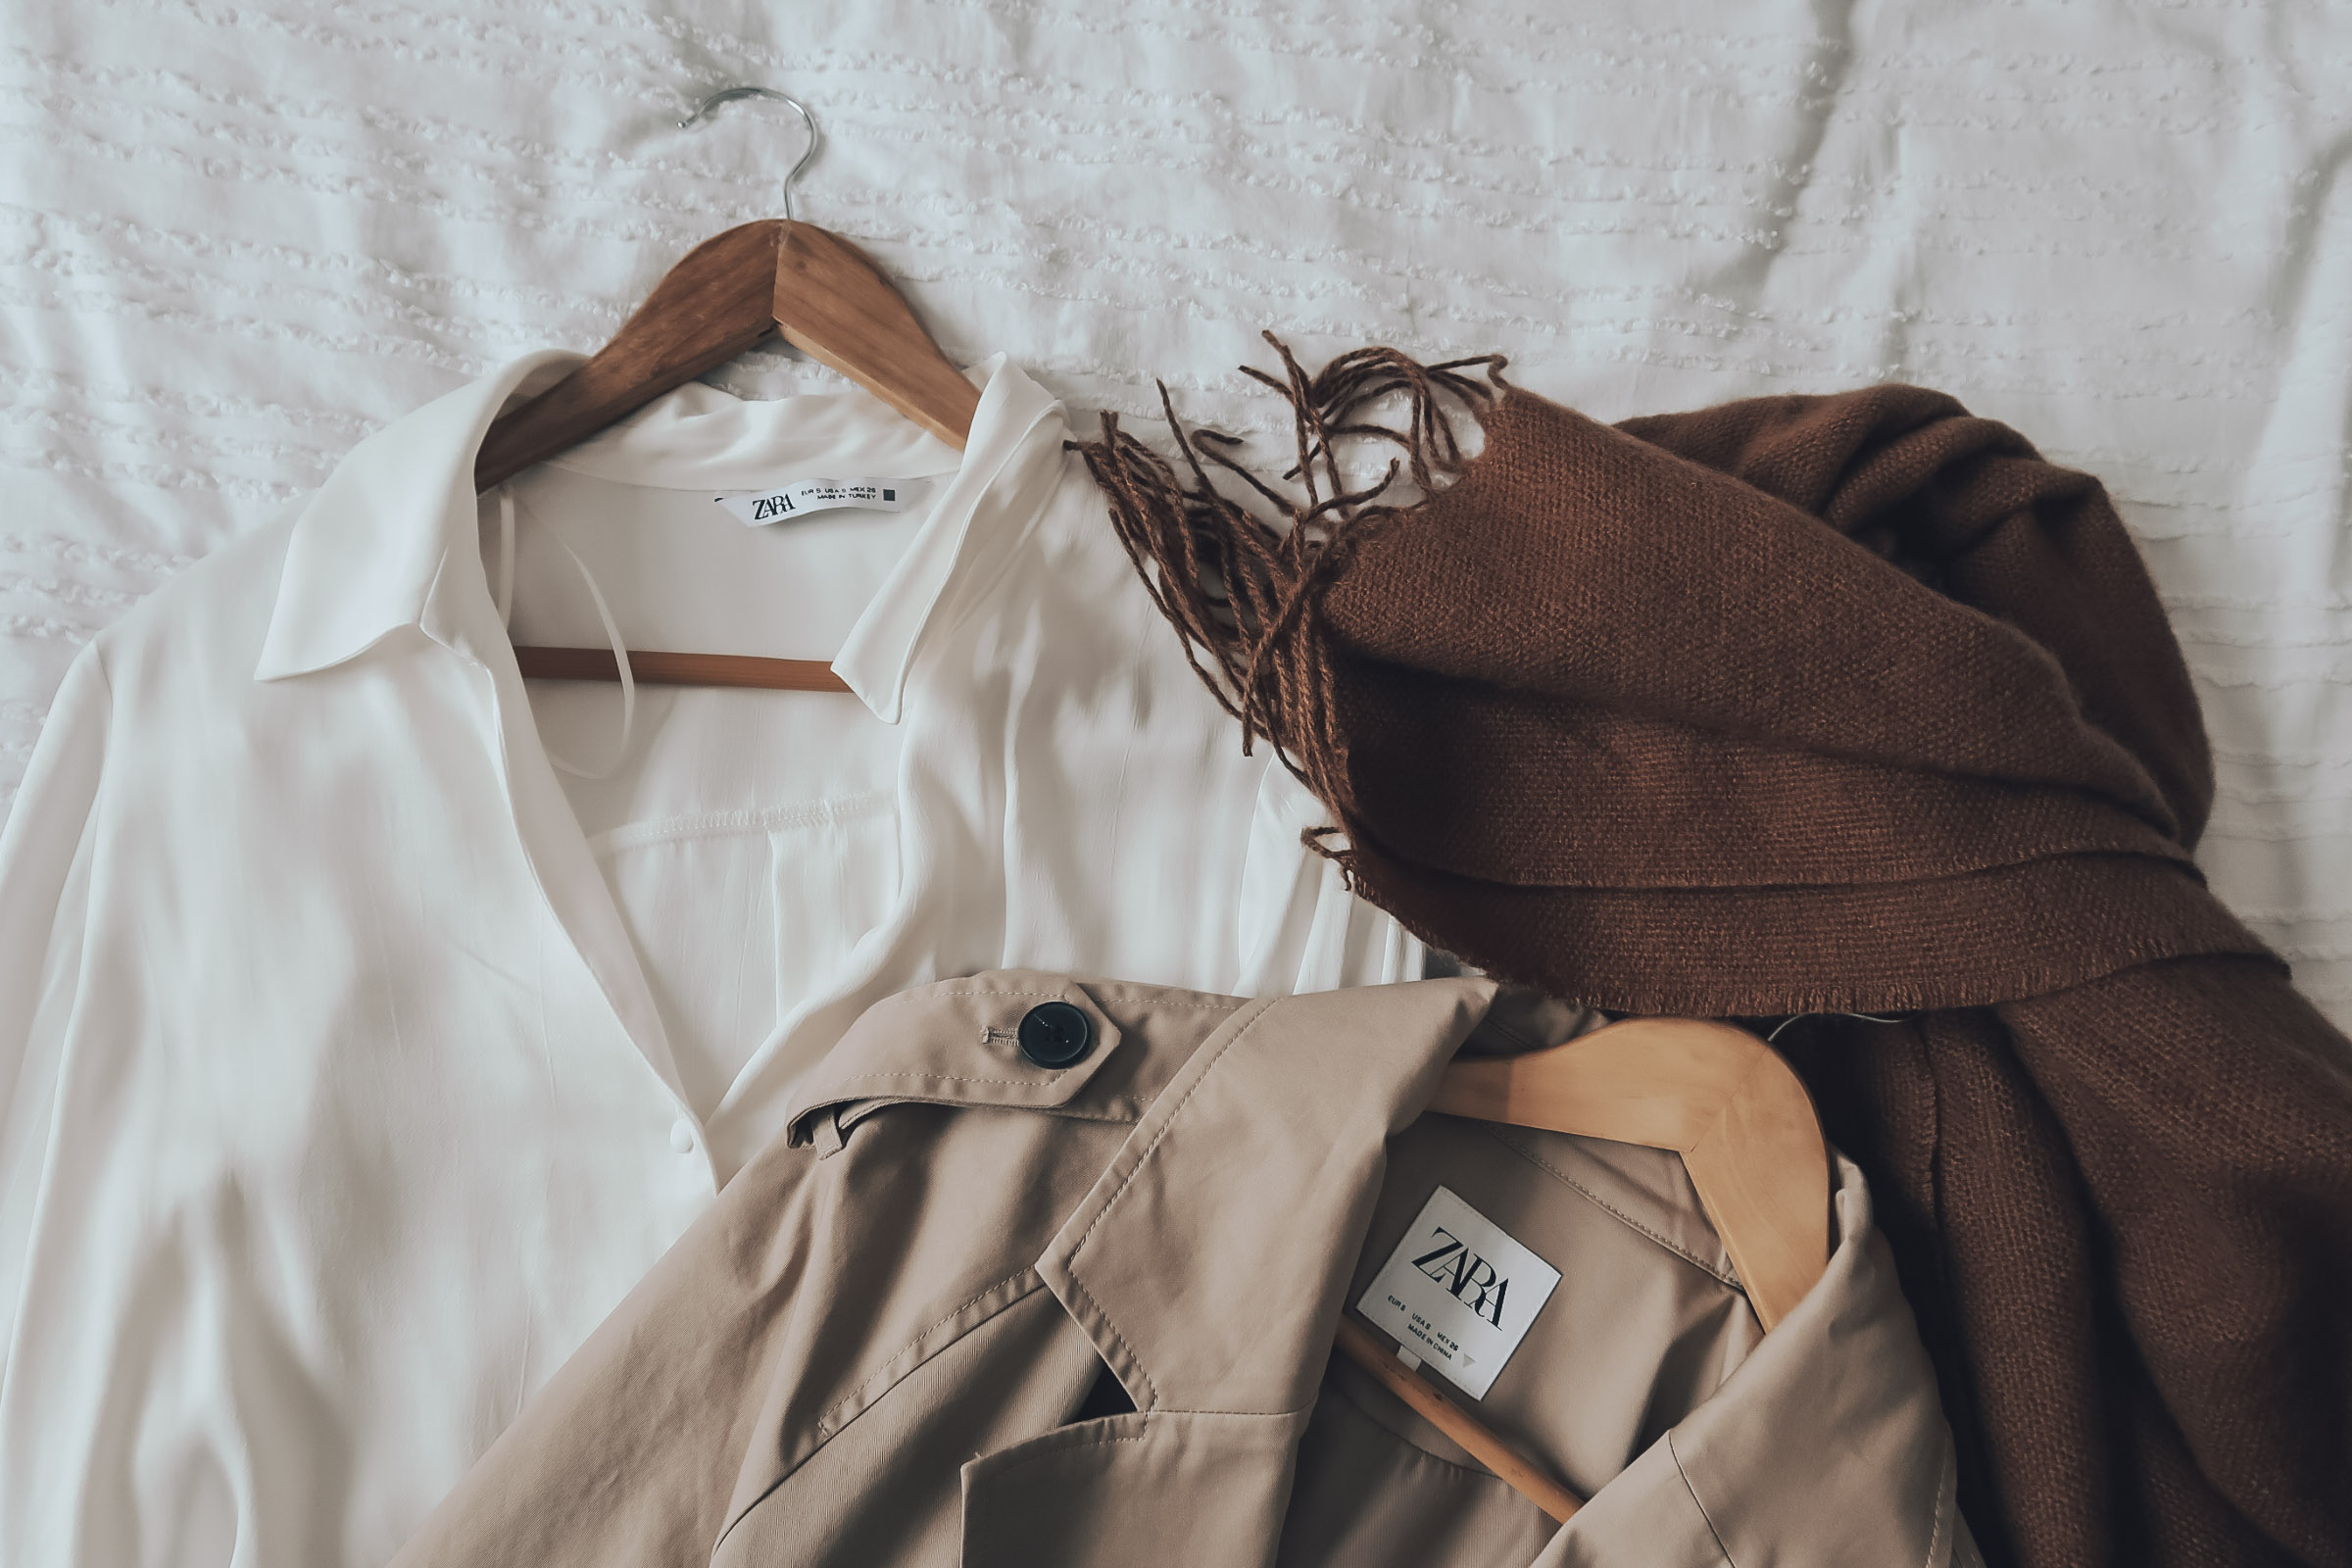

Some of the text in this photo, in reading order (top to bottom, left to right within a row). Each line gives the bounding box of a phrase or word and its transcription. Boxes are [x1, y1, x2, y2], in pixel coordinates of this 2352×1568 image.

[753, 493, 796, 519] ZARA
[1411, 1226, 1509, 1331] ZARA
[1388, 1295, 1401, 1308] EUR
[1411, 1312, 1425, 1327] USA
[1437, 1332, 1451, 1346] MEX
[1407, 1323, 1452, 1360] MADE IN CHINA
